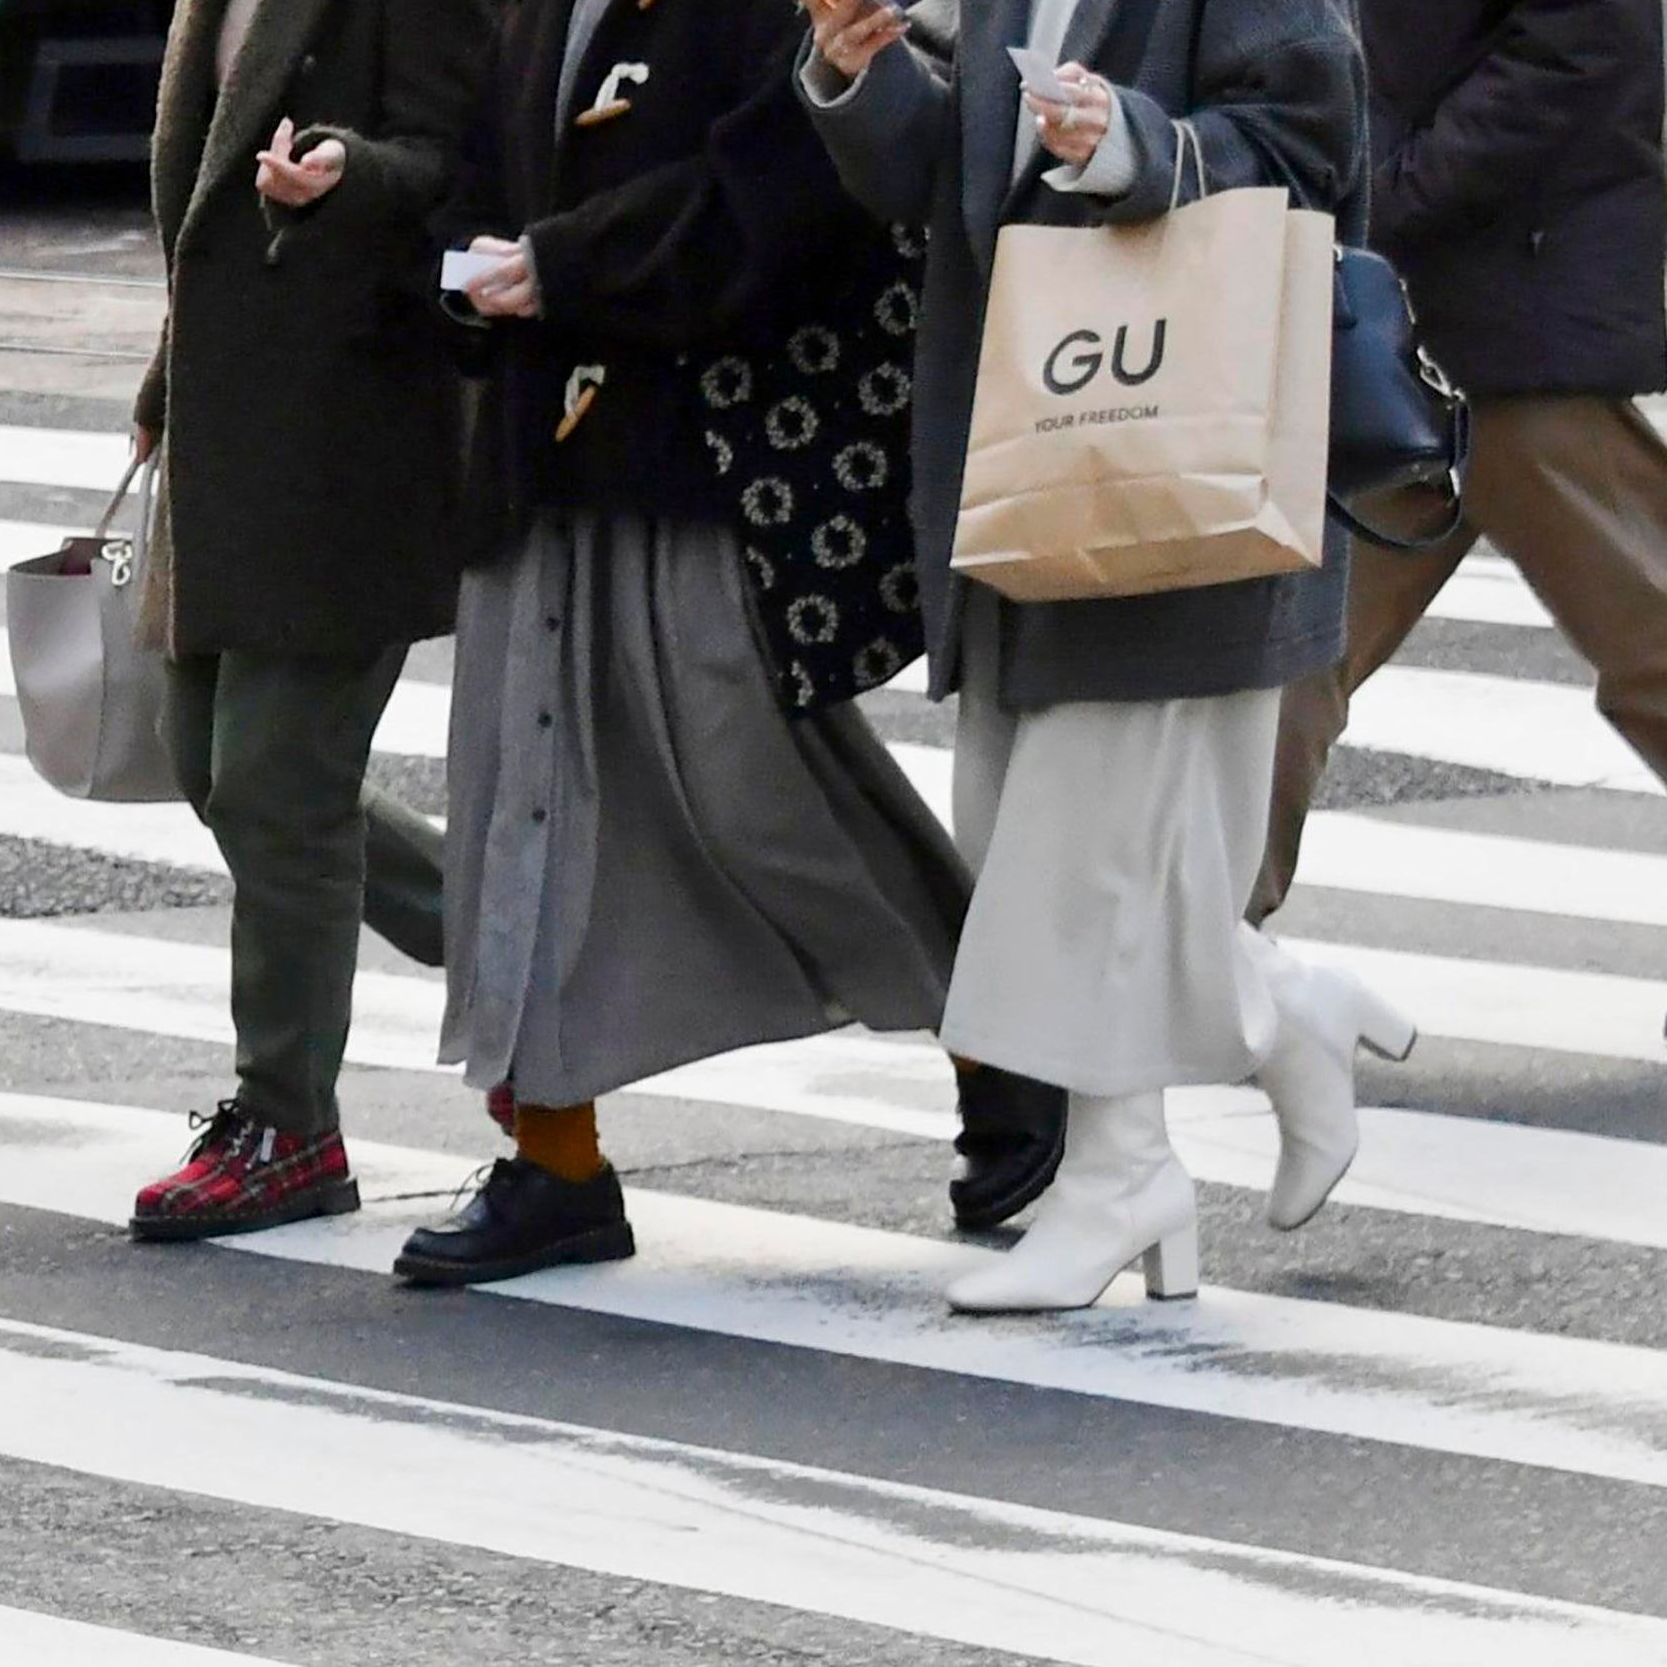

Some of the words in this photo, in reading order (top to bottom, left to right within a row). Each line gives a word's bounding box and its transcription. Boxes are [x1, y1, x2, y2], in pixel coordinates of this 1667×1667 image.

[1042, 317, 1167, 396] GU
[1034, 415, 1075, 434] YOUR
[1078, 404, 1159, 427] FREEDOM
